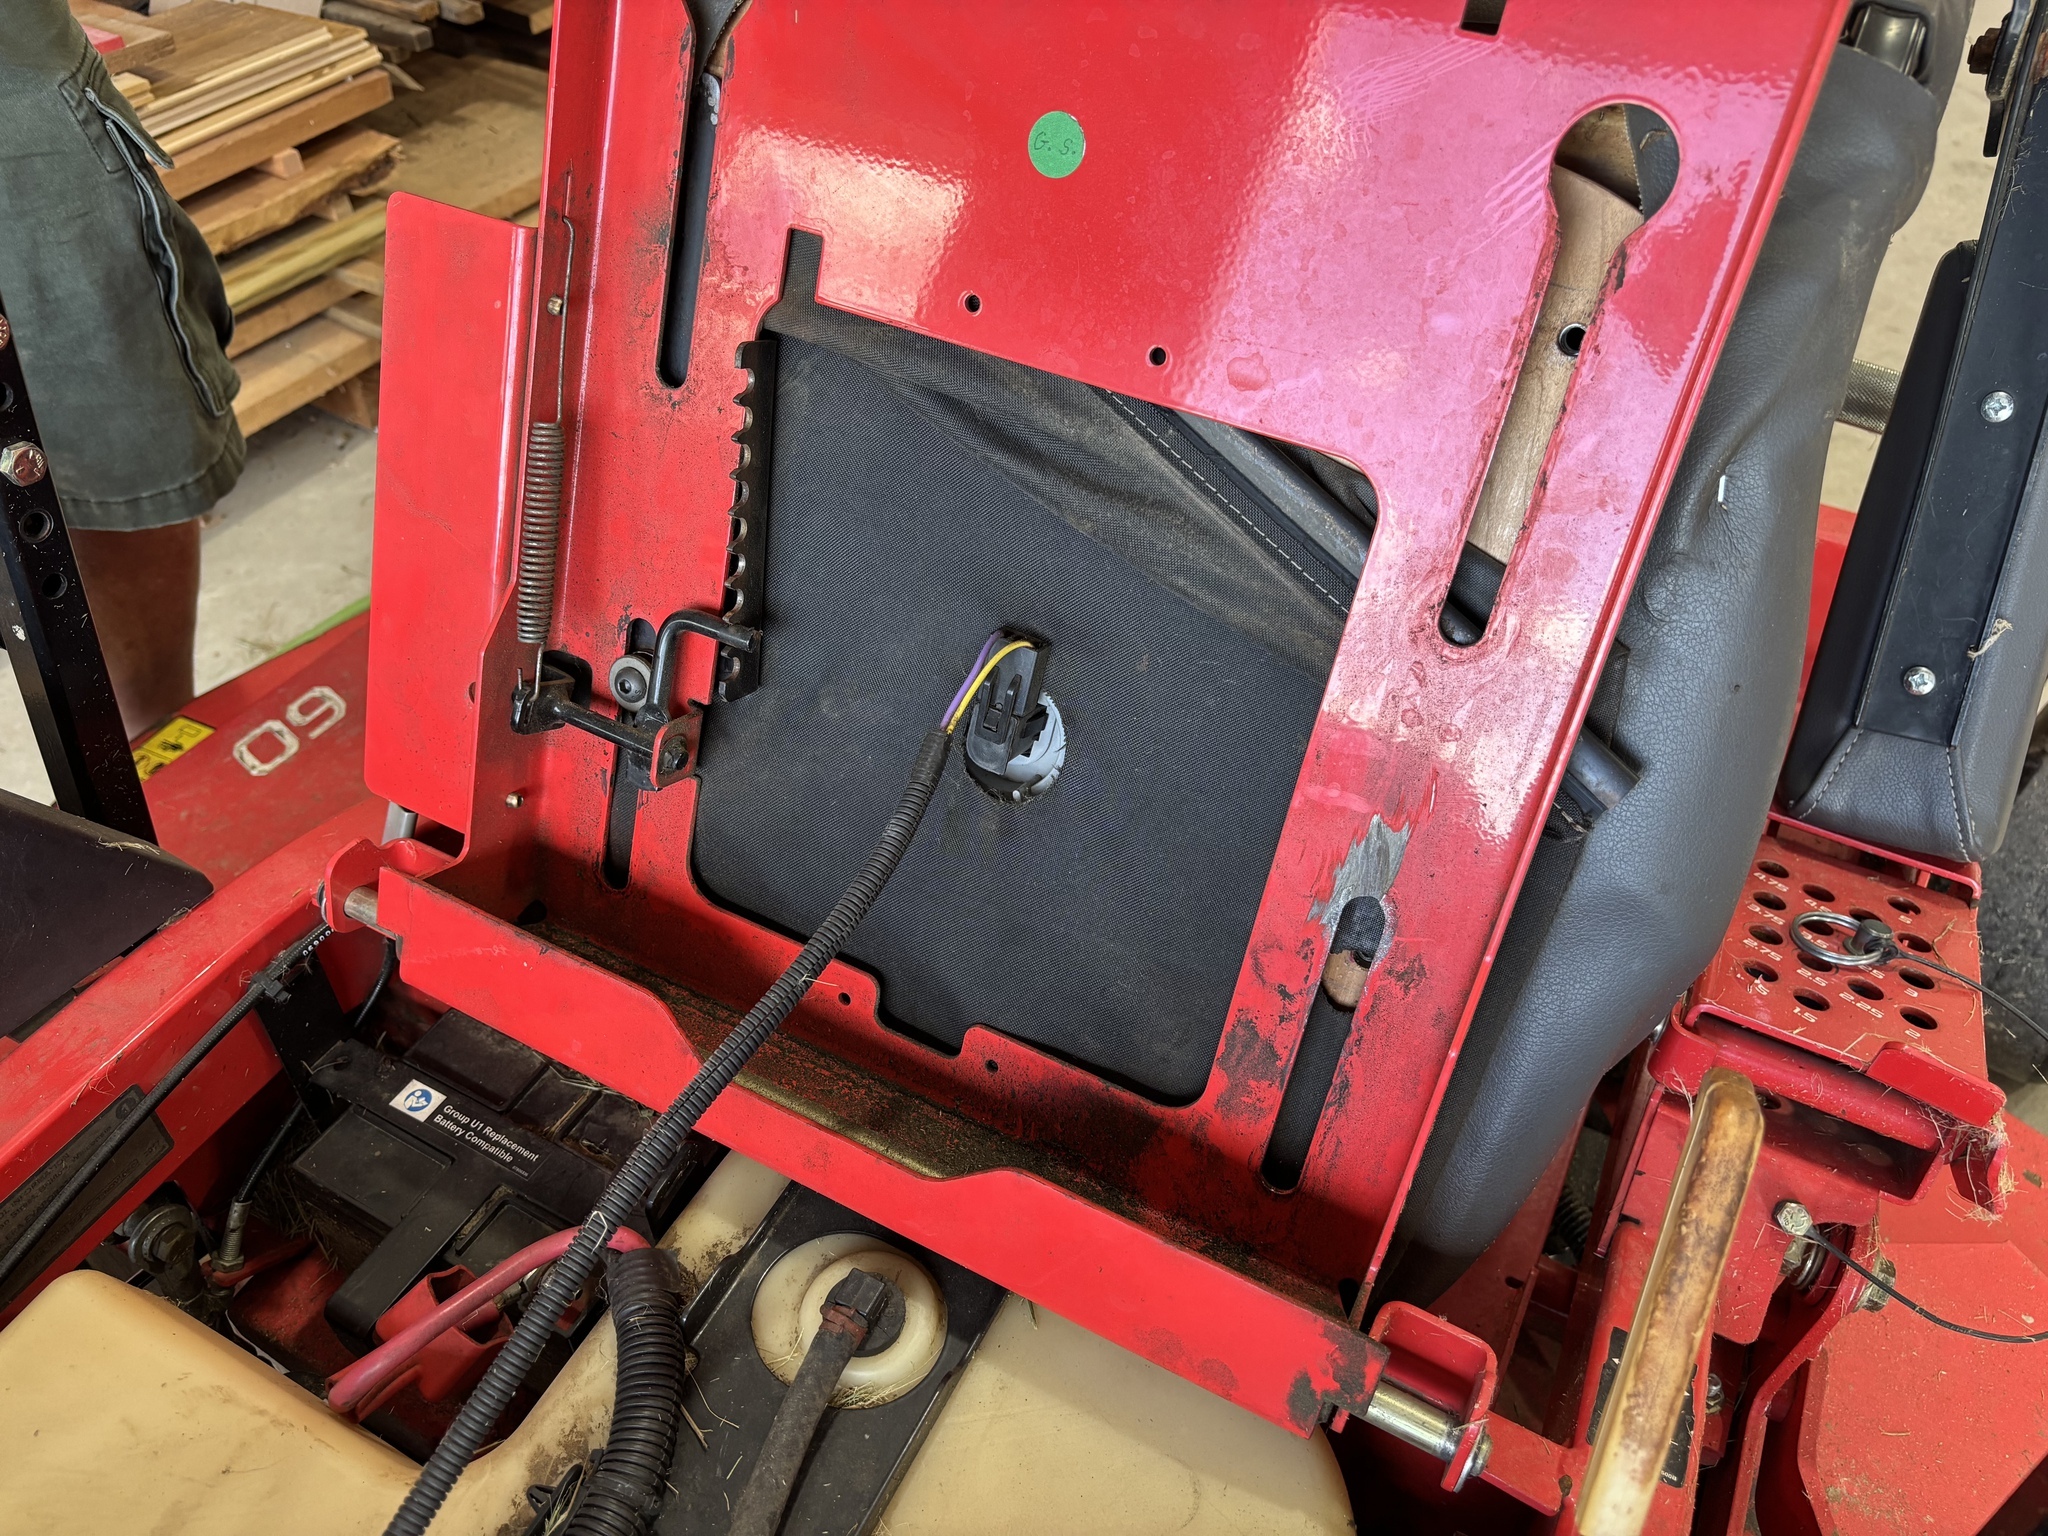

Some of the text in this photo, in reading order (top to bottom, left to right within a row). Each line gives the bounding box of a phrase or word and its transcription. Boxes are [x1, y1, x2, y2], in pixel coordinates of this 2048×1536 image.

[1753, 872, 1789, 892] 4.75
[1747, 903, 1786, 925] 3.75
[1898, 915, 1913, 925] 5
[1742, 937, 1783, 962] 2.75
[1796, 967, 1828, 987] 2.5
[1904, 987, 1919, 998] 3
[1793, 1006, 1818, 1023] 1.5
[1839, 991, 1884, 1018] 2.25
[1904, 1028, 1921, 1039] 2
[433, 1114, 514, 1163] Battery Compatible
[443, 1104, 540, 1163] Group U1 Replacement
